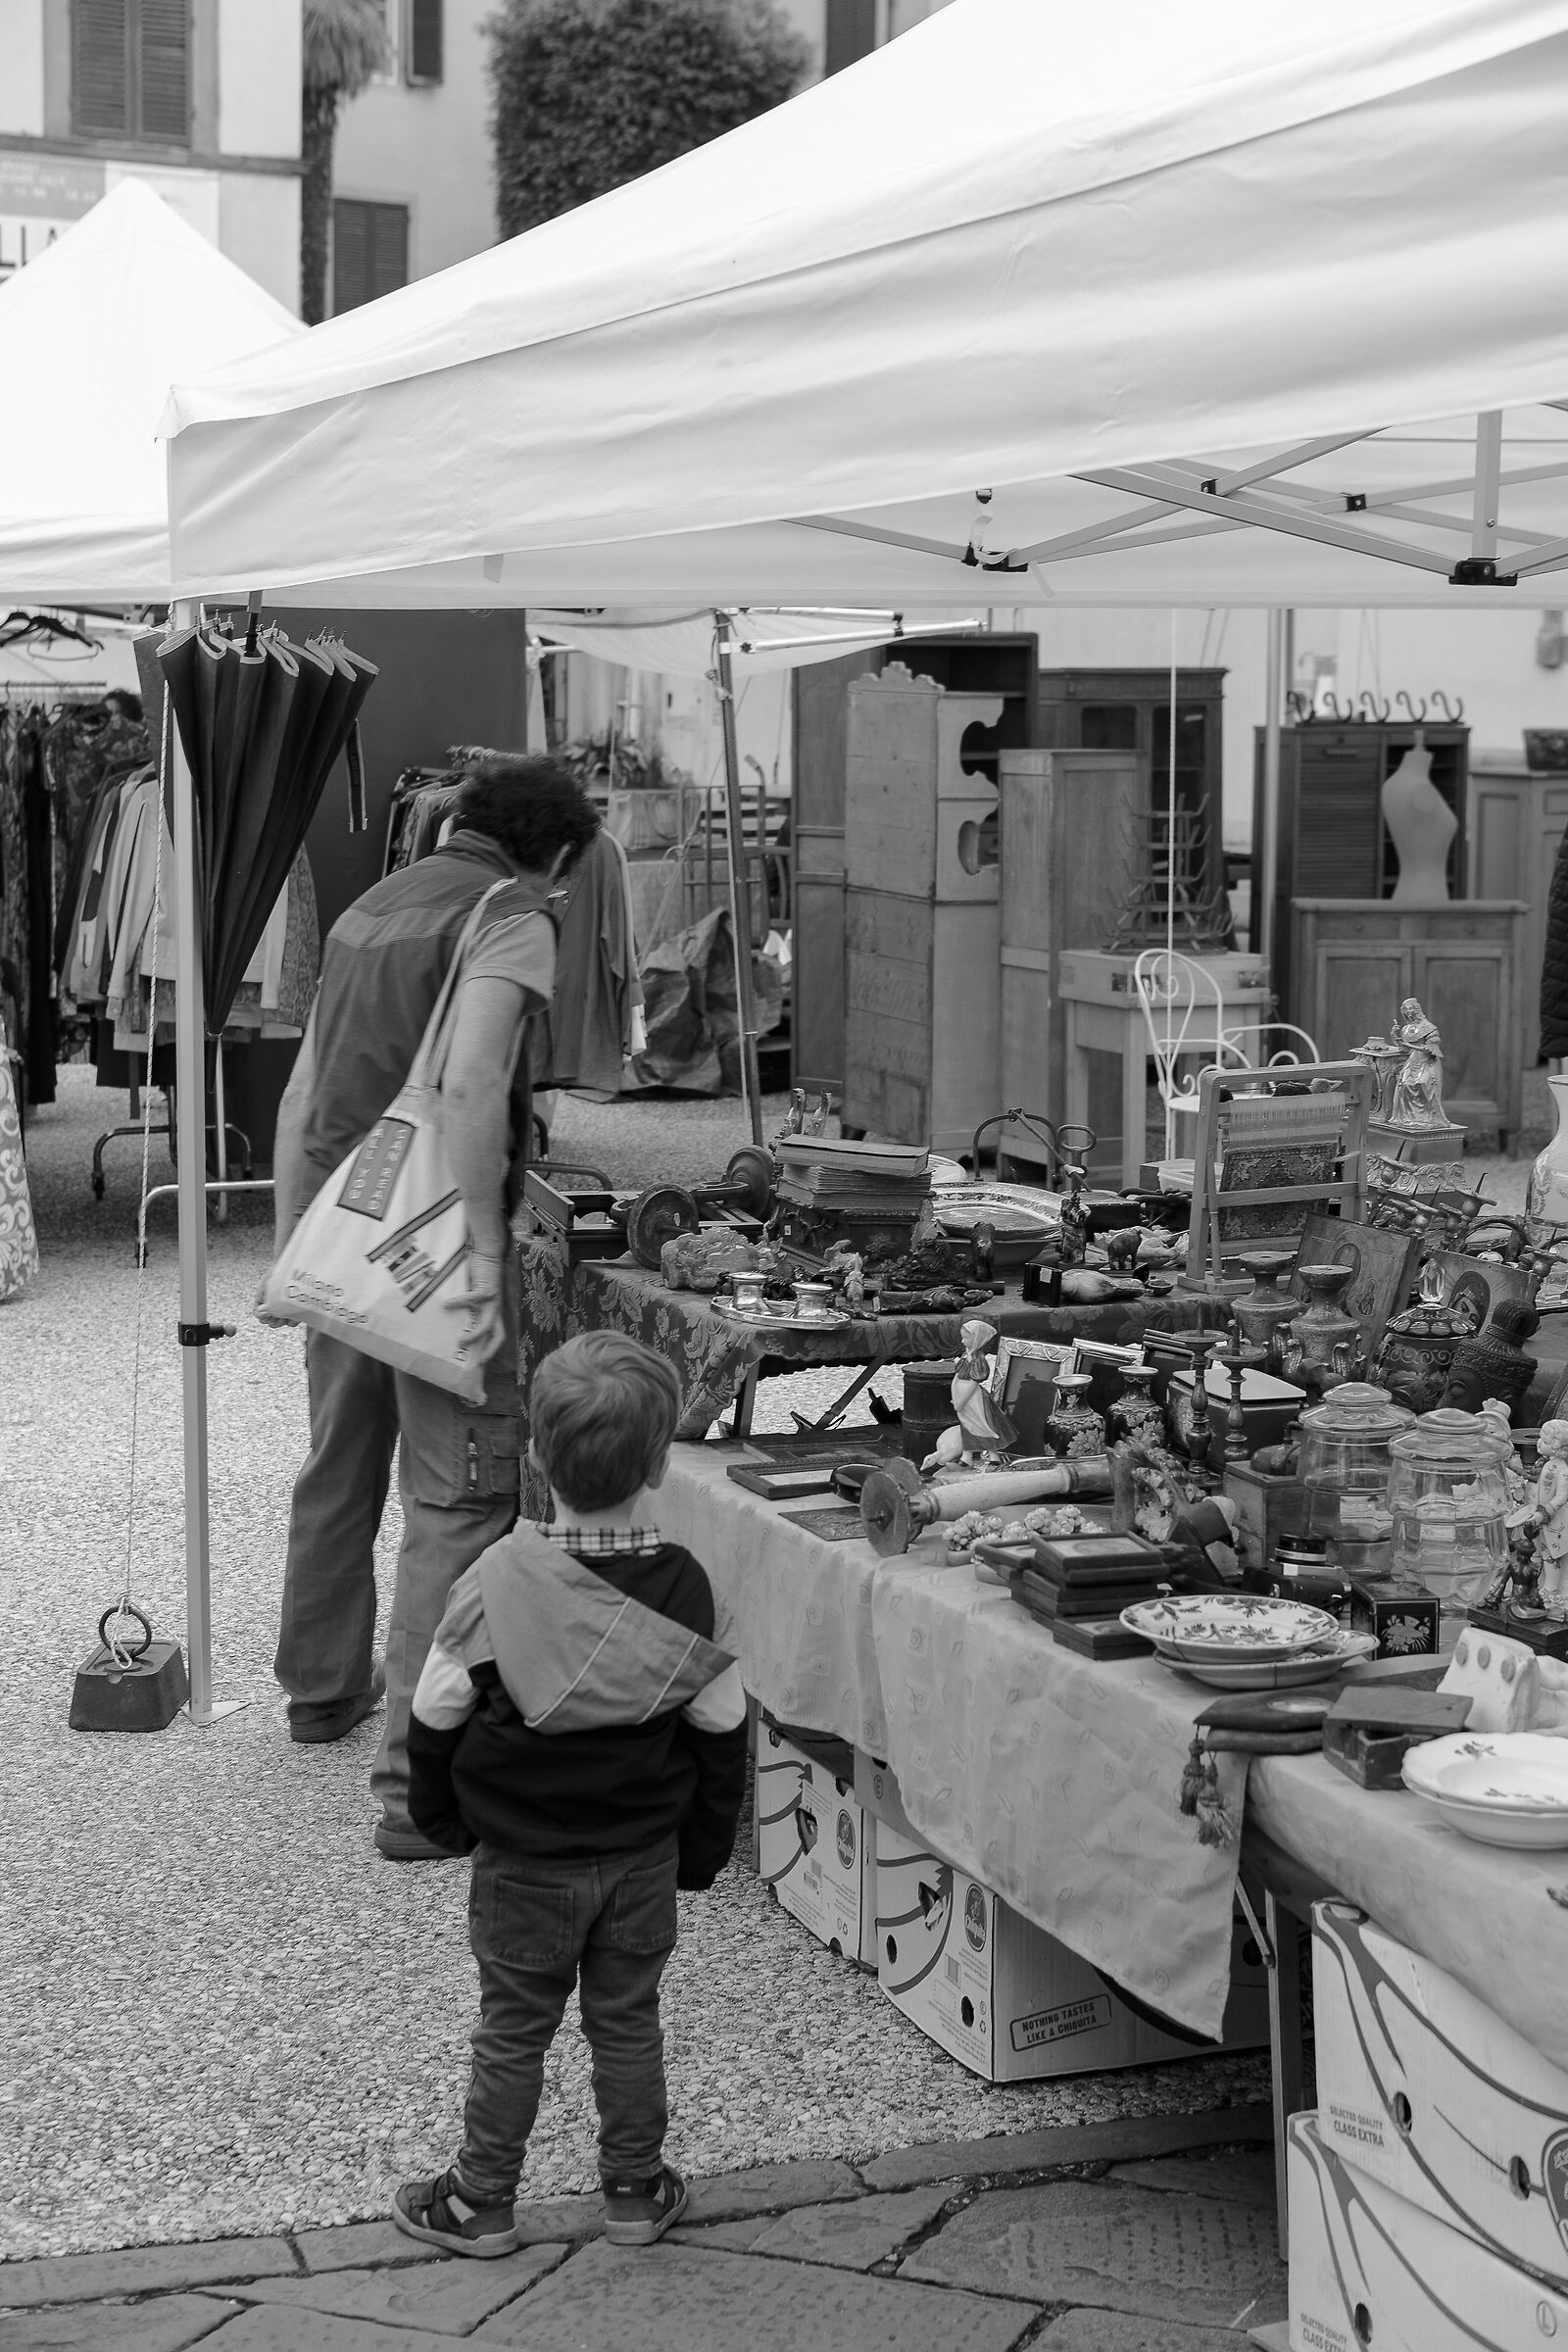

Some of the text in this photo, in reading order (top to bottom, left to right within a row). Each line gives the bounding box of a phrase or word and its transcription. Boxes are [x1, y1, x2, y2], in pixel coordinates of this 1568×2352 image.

[1022, 2002, 1095, 2032] NOTHING TASTES
[1027, 2015, 1097, 2043] LIKE A CHIQUITA
[1330, 2105, 1382, 2130] SELECTED QUALITY
[1334, 2120, 1384, 2148] CLASS EXTRA
[1302, 2328, 1347, 2352] CLASS EXT
